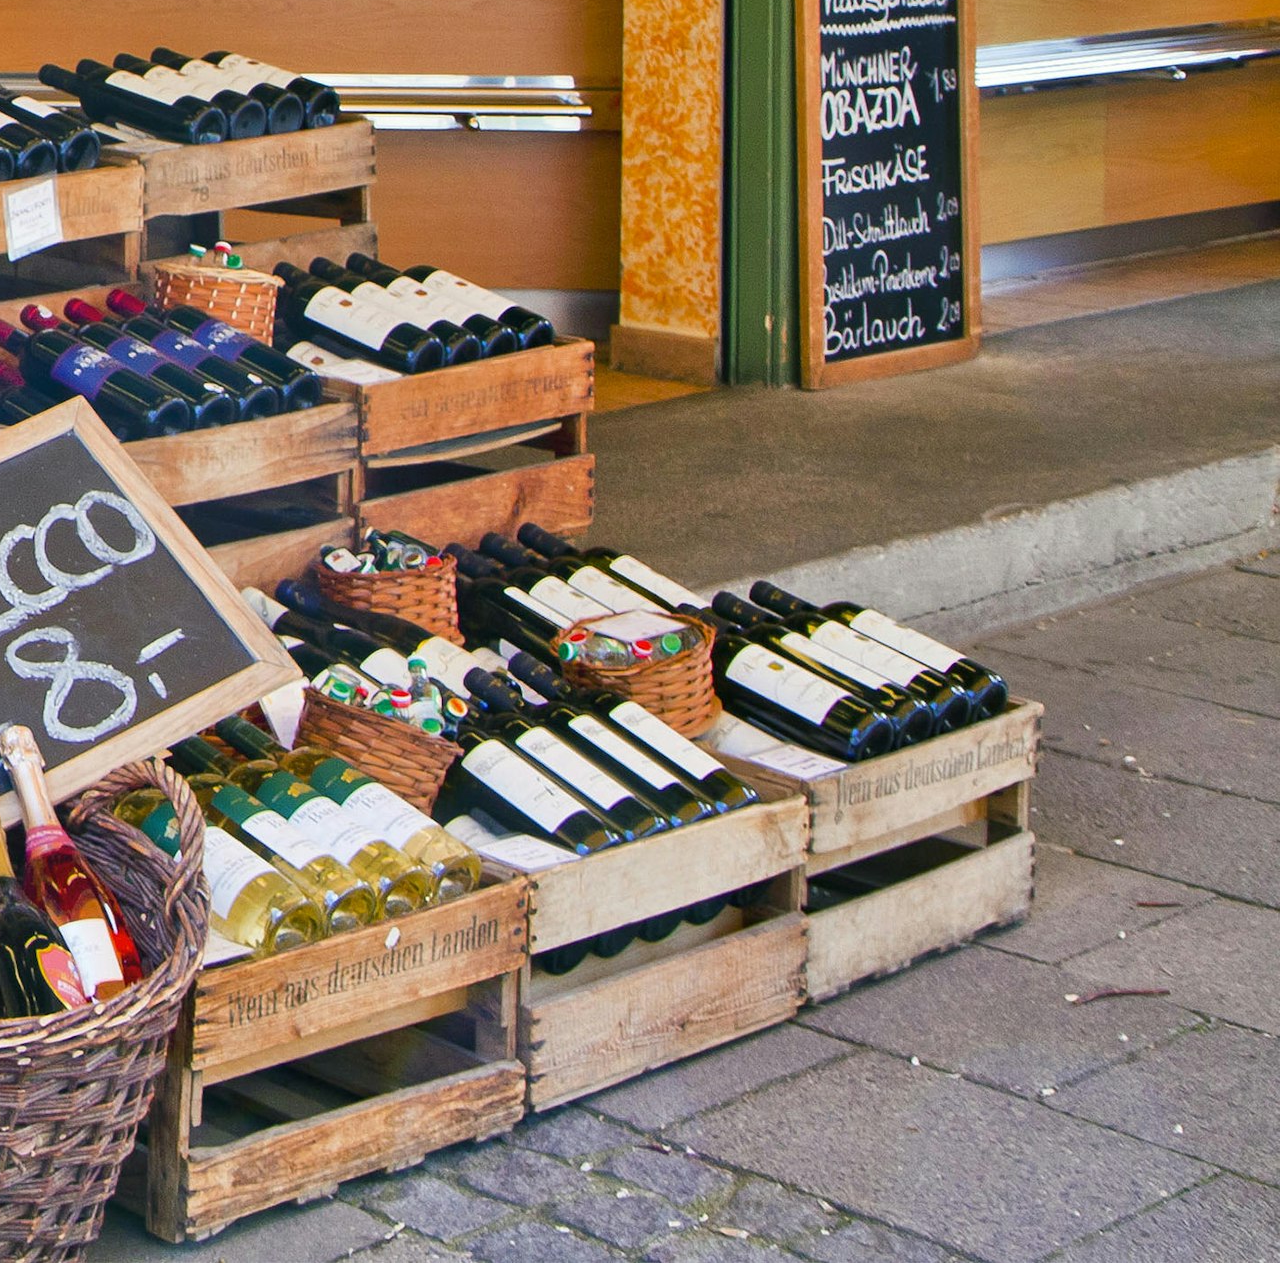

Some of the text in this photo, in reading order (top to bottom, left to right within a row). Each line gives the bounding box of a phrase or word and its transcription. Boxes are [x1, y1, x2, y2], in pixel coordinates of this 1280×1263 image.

[821, 45, 918, 89] MÜNCHNER
[820, 78, 920, 141] OBAZDA
[821, 143, 931, 197] FRISCHKÄSE
[823, 296, 925, 356] Bärlauch
[228, 914, 501, 1027] Wein aus deutschen Landen
